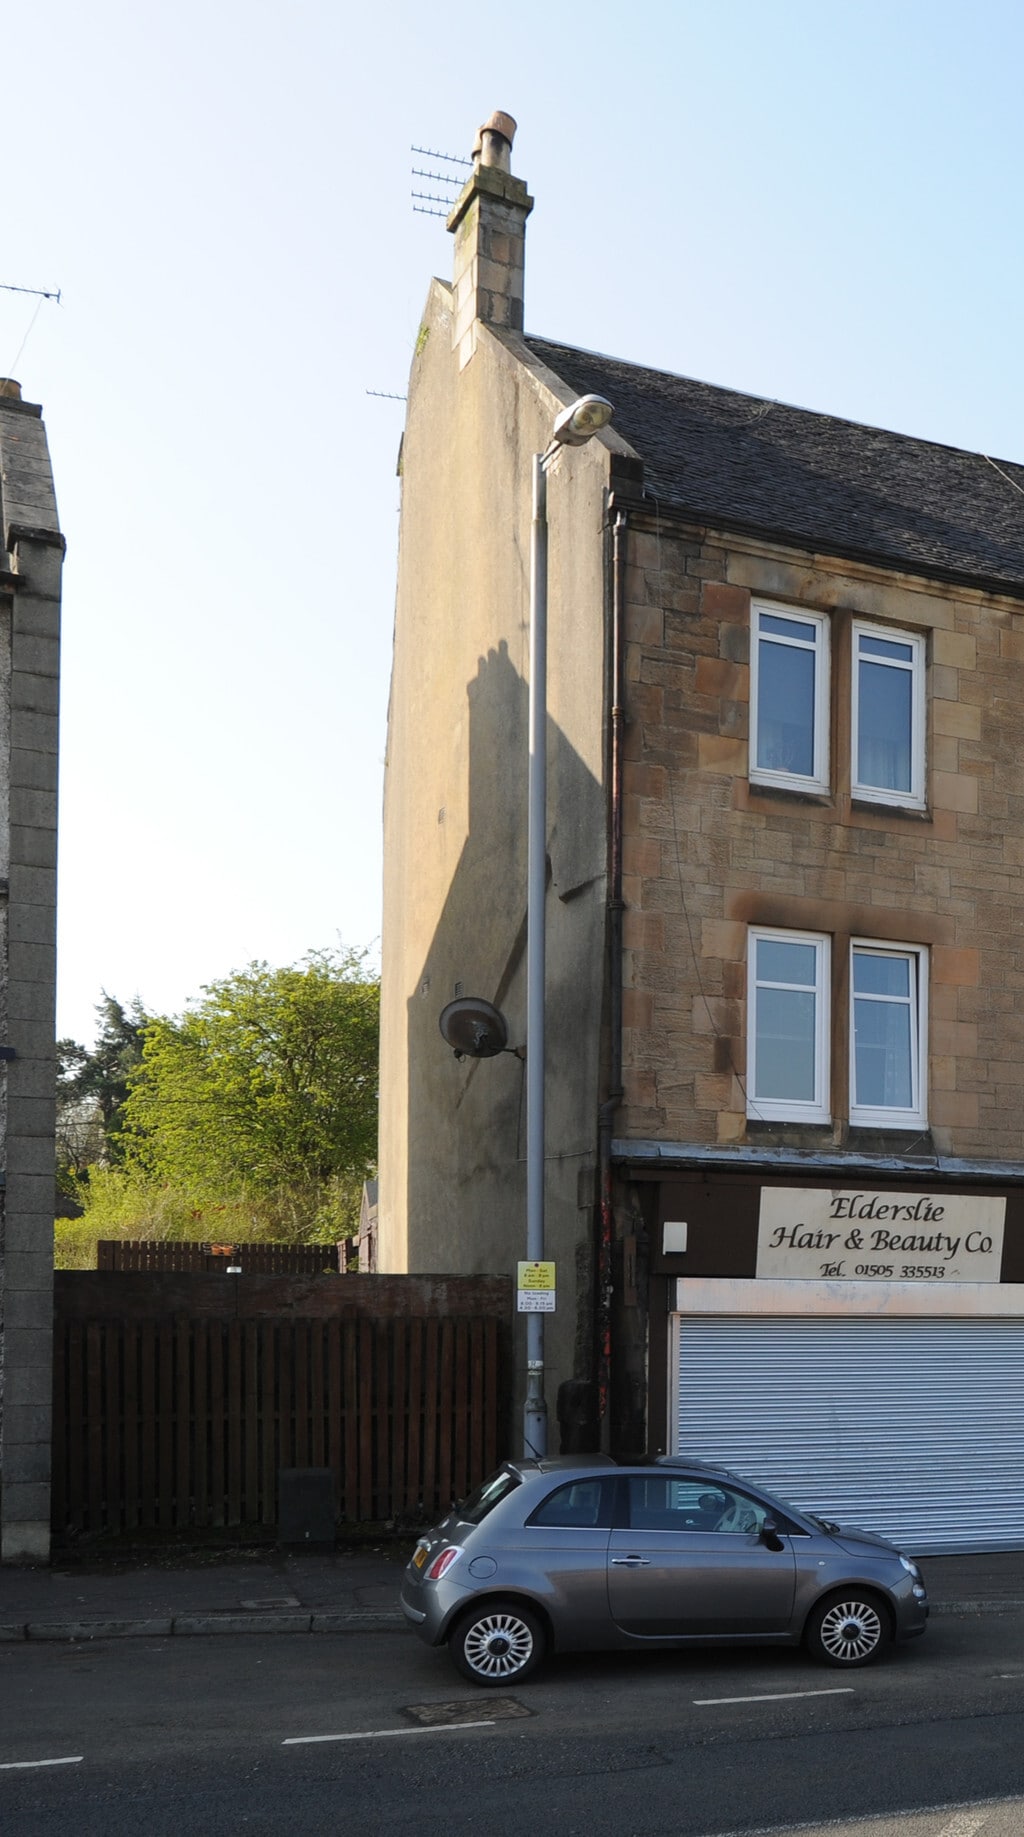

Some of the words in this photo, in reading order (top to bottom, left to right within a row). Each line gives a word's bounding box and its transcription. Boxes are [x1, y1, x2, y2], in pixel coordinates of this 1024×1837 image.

[829, 1194, 945, 1222] Elderslie
[769, 1223, 841, 1250] Hair
[844, 1228, 864, 1250] &
[870, 1229, 961, 1260] Beauty
[819, 1260, 847, 1278] Tel.
[855, 1264, 894, 1278] 01505
[900, 1265, 946, 1279] 335513
